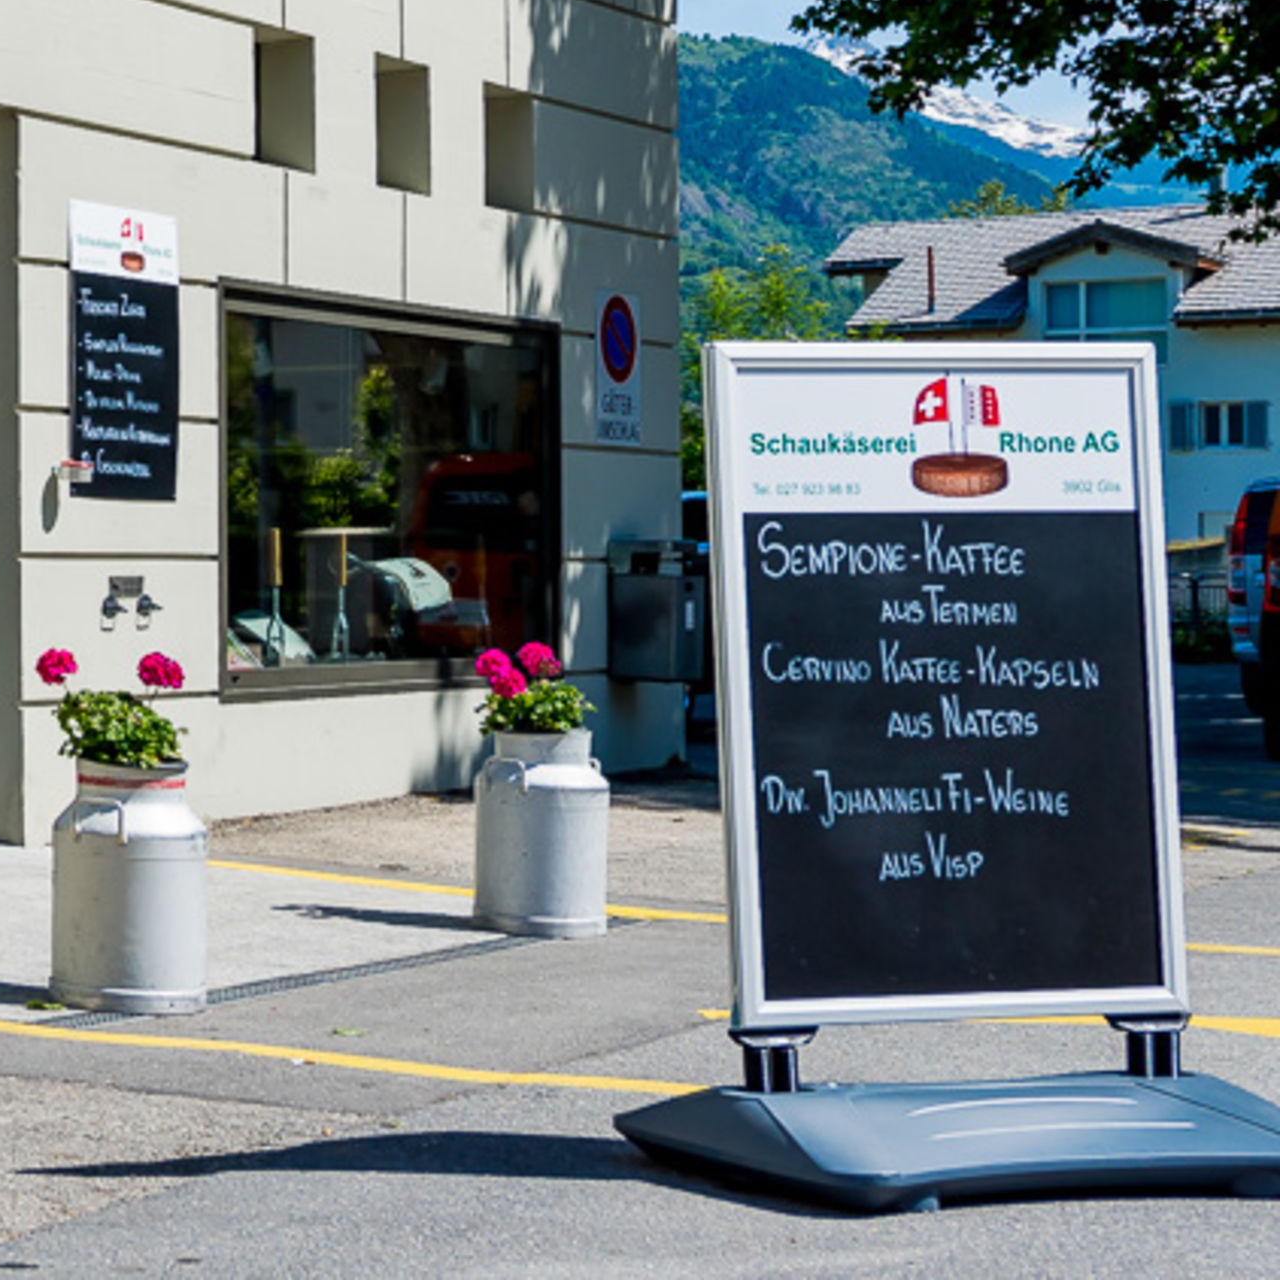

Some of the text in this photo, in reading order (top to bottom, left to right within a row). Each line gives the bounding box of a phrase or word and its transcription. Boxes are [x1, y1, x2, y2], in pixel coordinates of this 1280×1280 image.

[750, 431, 917, 456] Schaukäserei
[999, 430, 1120, 453] Rhone AG
[880, 584, 1017, 626] AUS TERMEN
[762, 642, 871, 684] CERVINO
[887, 693, 1039, 739] AUS NATERS
[879, 831, 984, 881] AUS VISP
